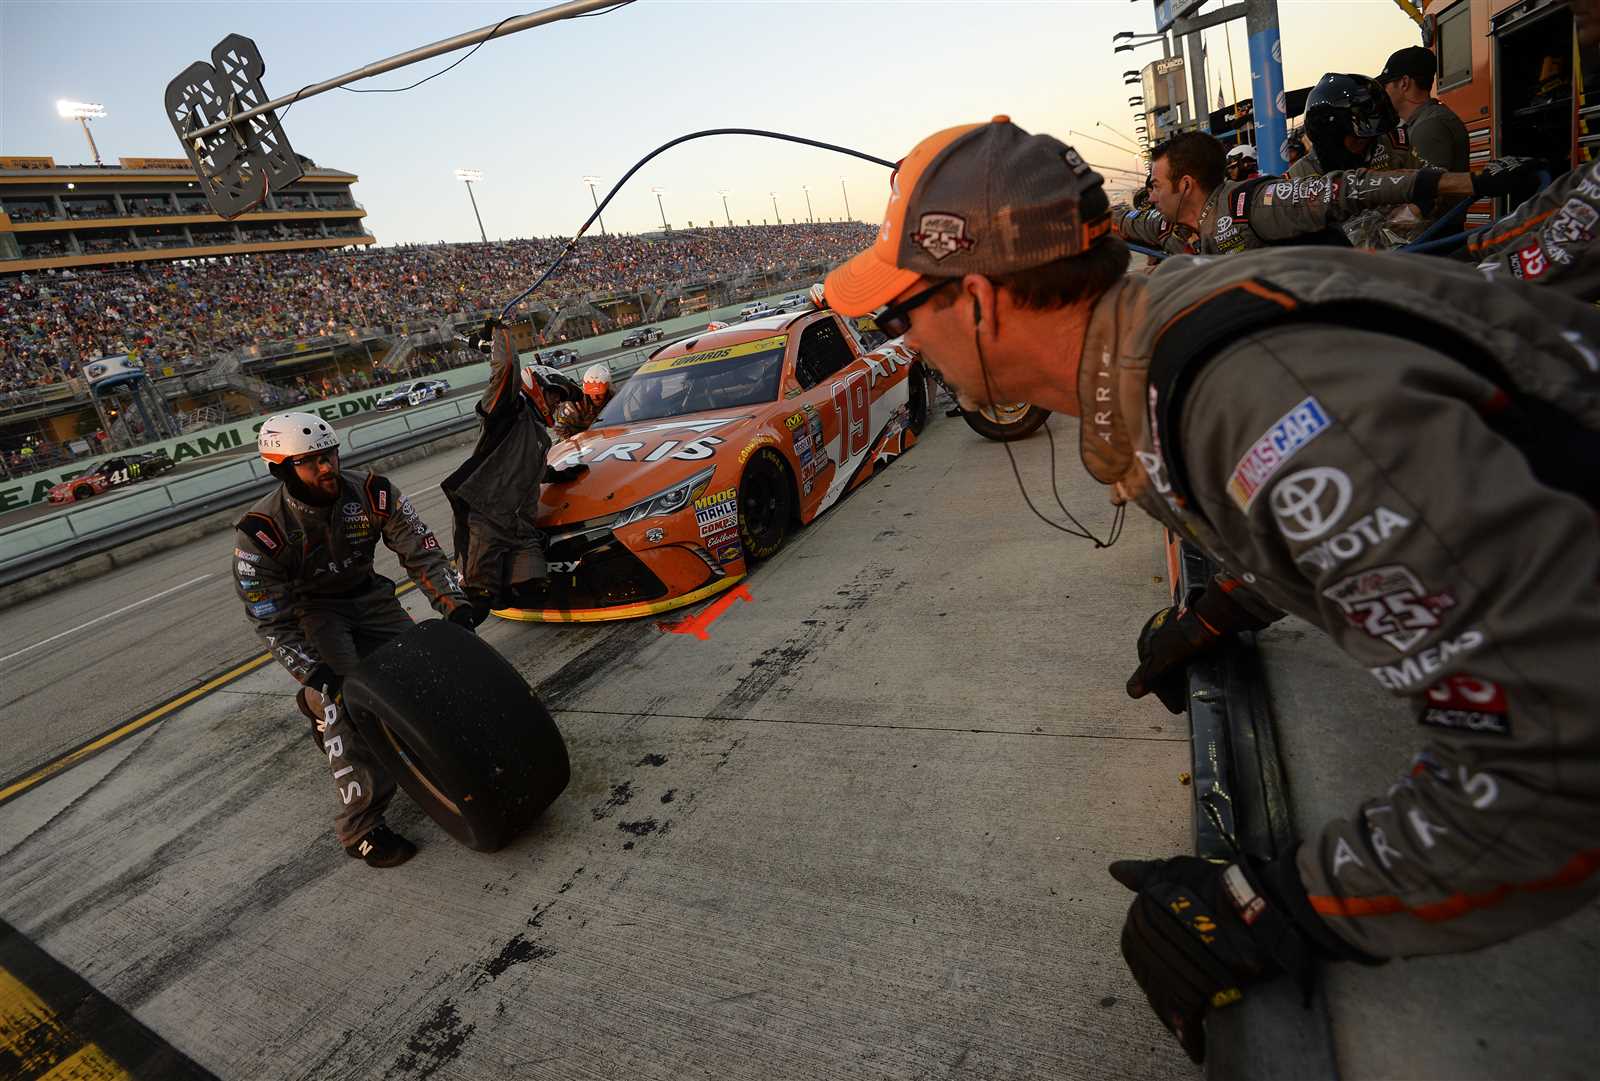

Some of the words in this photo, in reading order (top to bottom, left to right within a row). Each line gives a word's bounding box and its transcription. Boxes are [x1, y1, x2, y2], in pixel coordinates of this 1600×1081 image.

[922, 230, 958, 251] 25
[671, 348, 731, 367] EDWARDS
[832, 369, 870, 467] 19
[156, 428, 242, 462] AMI
[1233, 398, 1330, 504] NASCAR
[109, 468, 130, 485] 41
[694, 487, 737, 509] MOOG
[696, 500, 737, 524] MAHLE
[702, 518, 730, 535] COMP
[547, 561, 582, 574] RY
[1351, 589, 1441, 639] 25
[358, 839, 374, 857] N
